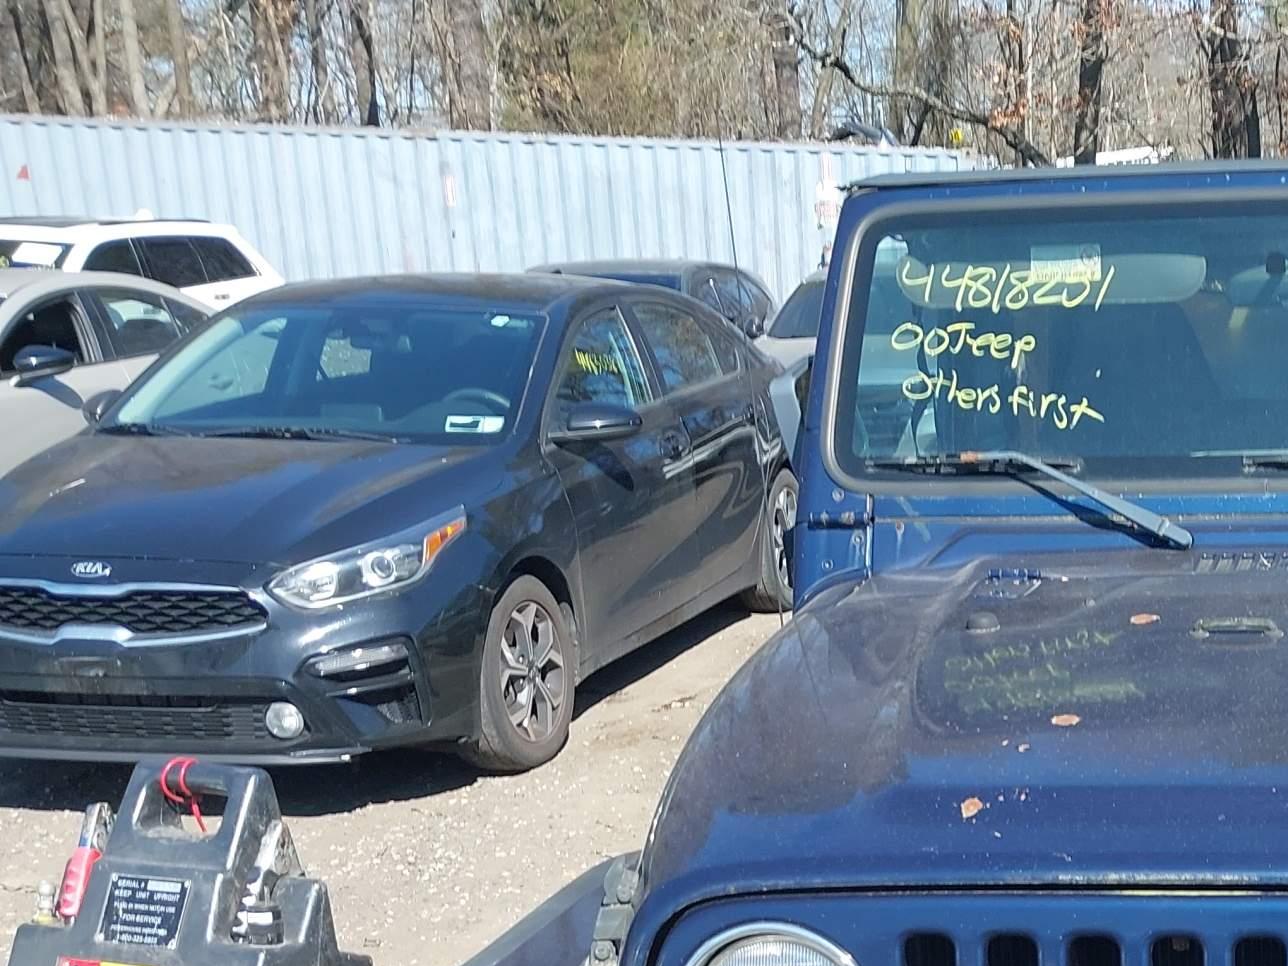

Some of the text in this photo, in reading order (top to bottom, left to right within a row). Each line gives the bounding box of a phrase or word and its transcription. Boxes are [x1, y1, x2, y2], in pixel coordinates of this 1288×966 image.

[74, 561, 104, 576] KIA
[114, 888, 132, 898] KEEP
[135, 890, 150, 899] UNIT
